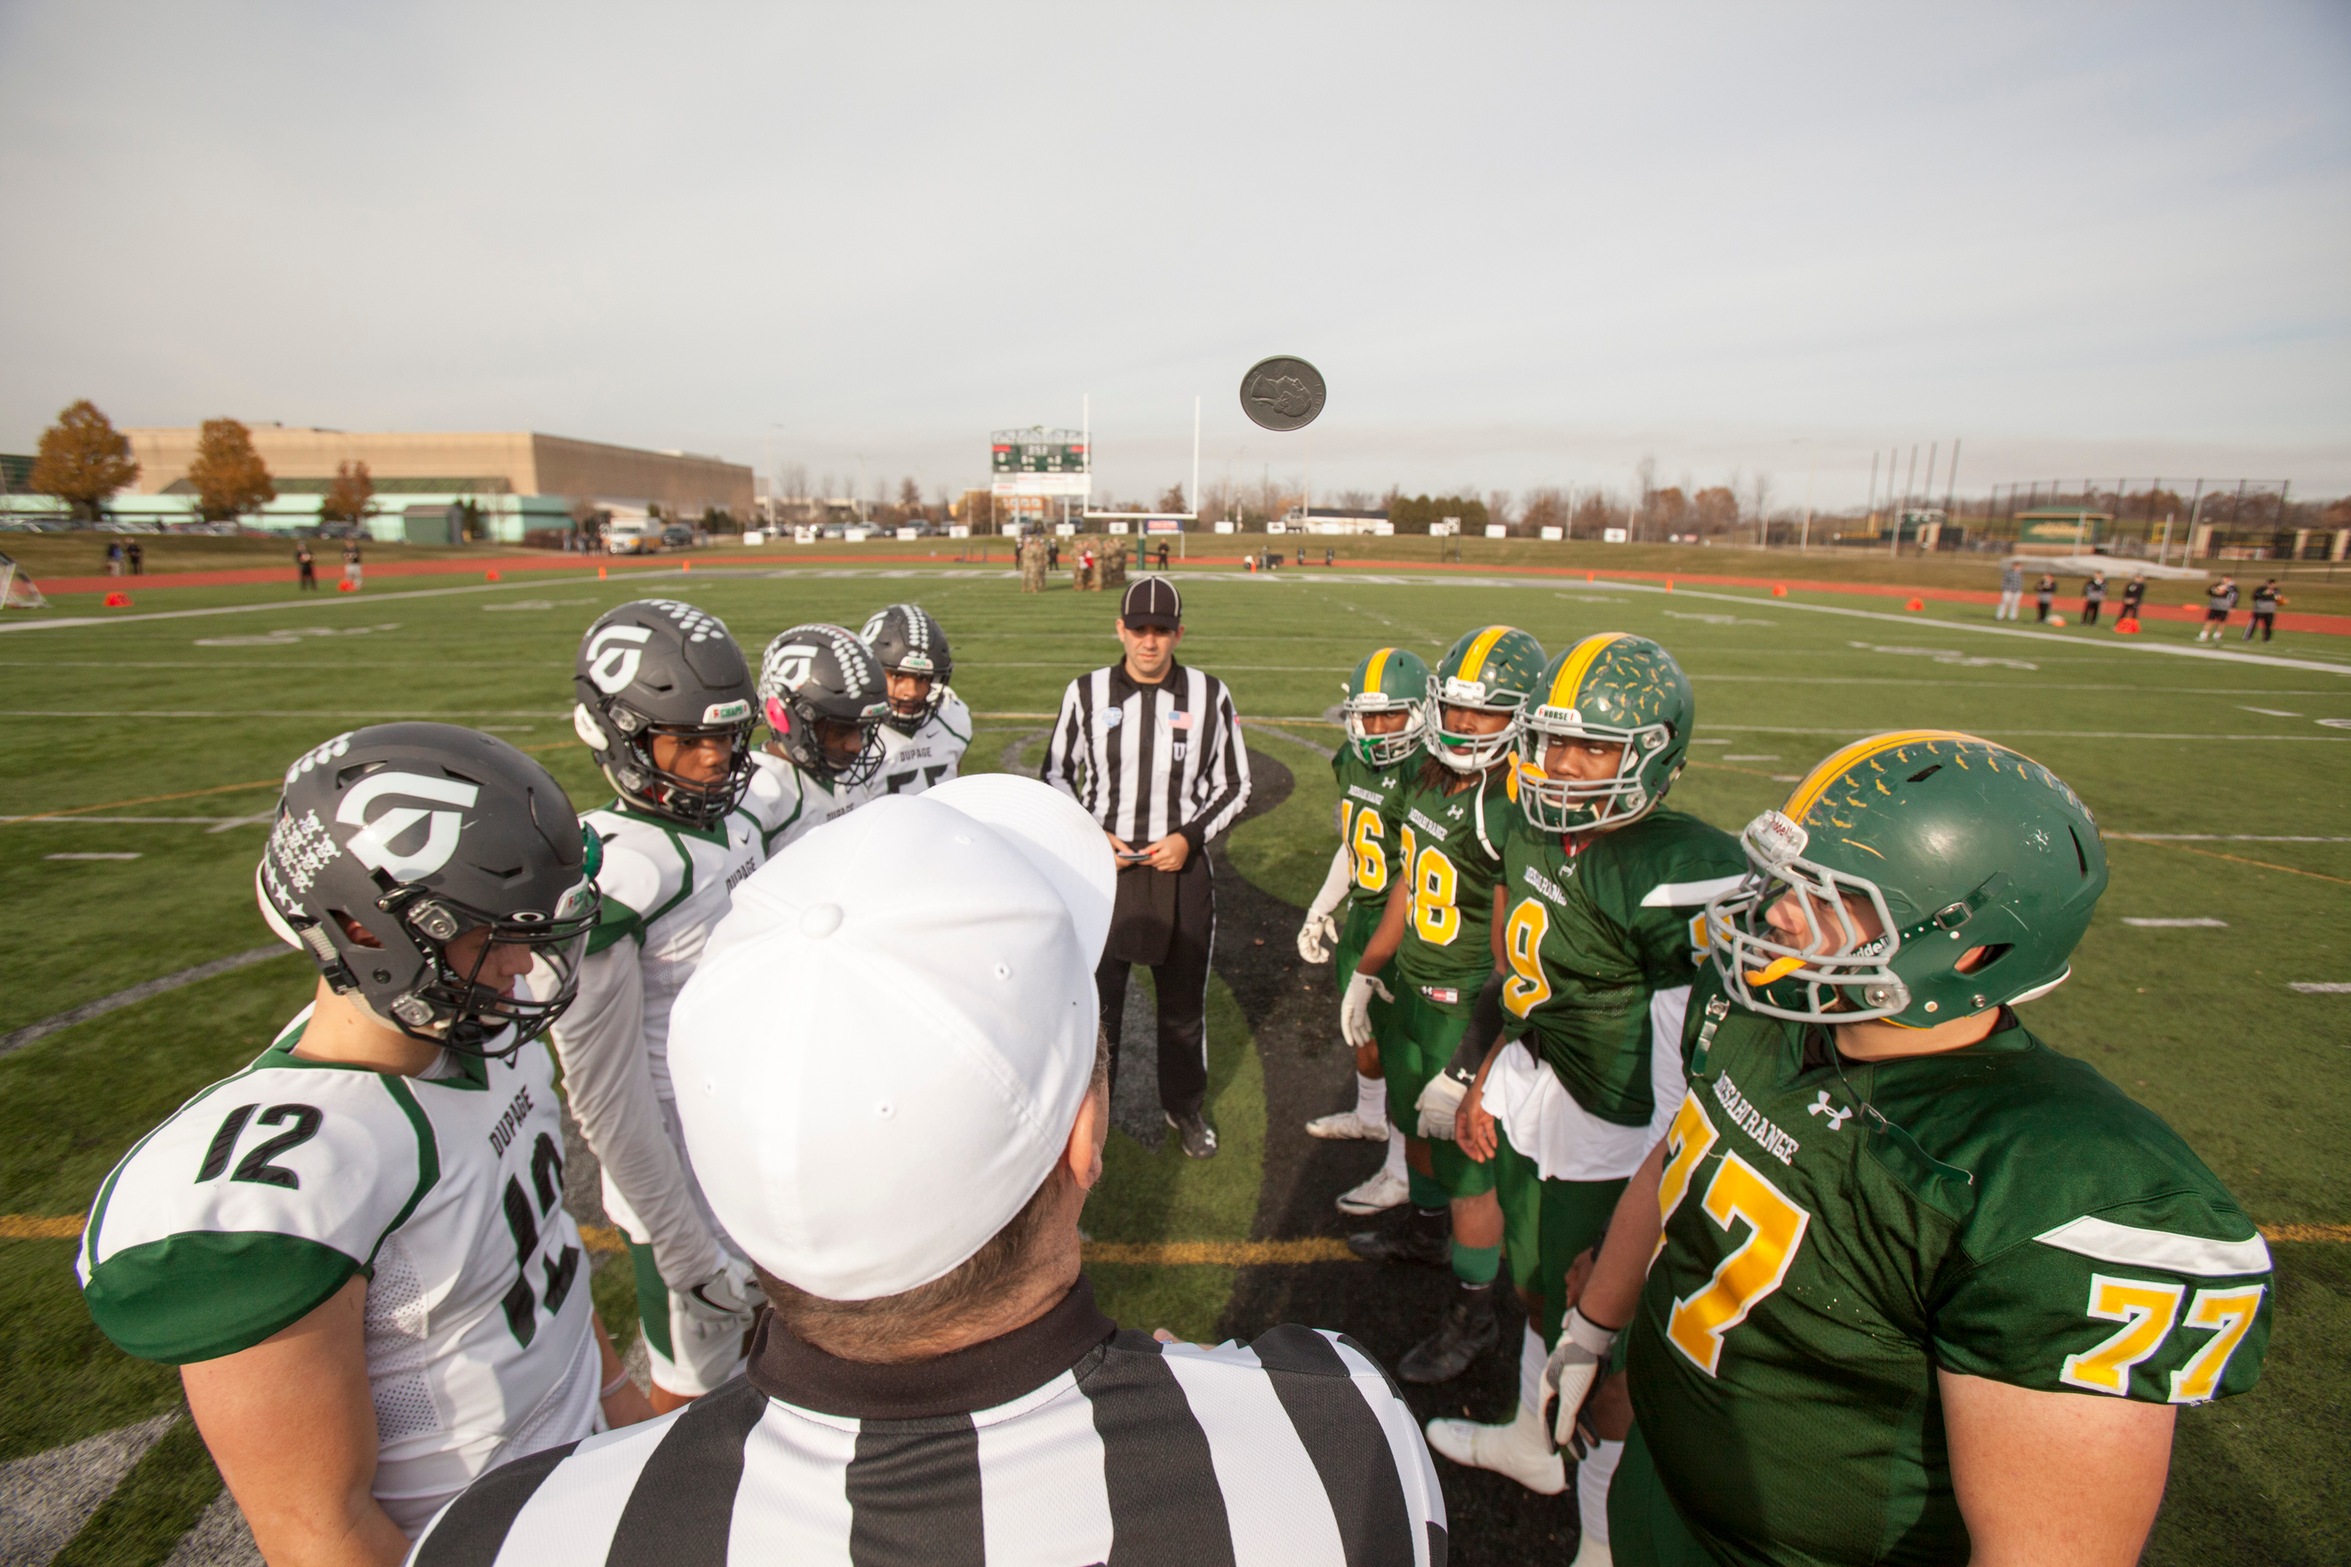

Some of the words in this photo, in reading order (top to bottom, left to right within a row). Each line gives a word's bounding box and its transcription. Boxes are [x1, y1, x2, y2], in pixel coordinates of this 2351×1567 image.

[901, 747, 932, 761] DUPAGE
[1173, 742, 1186, 761] U
[1342, 798, 1387, 892] 16
[1503, 897, 1551, 1019] 9
[194, 1103, 324, 1190] 12
[488, 1085, 534, 1159] DUPAGE
[1741, 1109, 1800, 1165] RANGE
[1645, 1087, 1810, 1378] 77
[2059, 1273, 2266, 1403] 77
